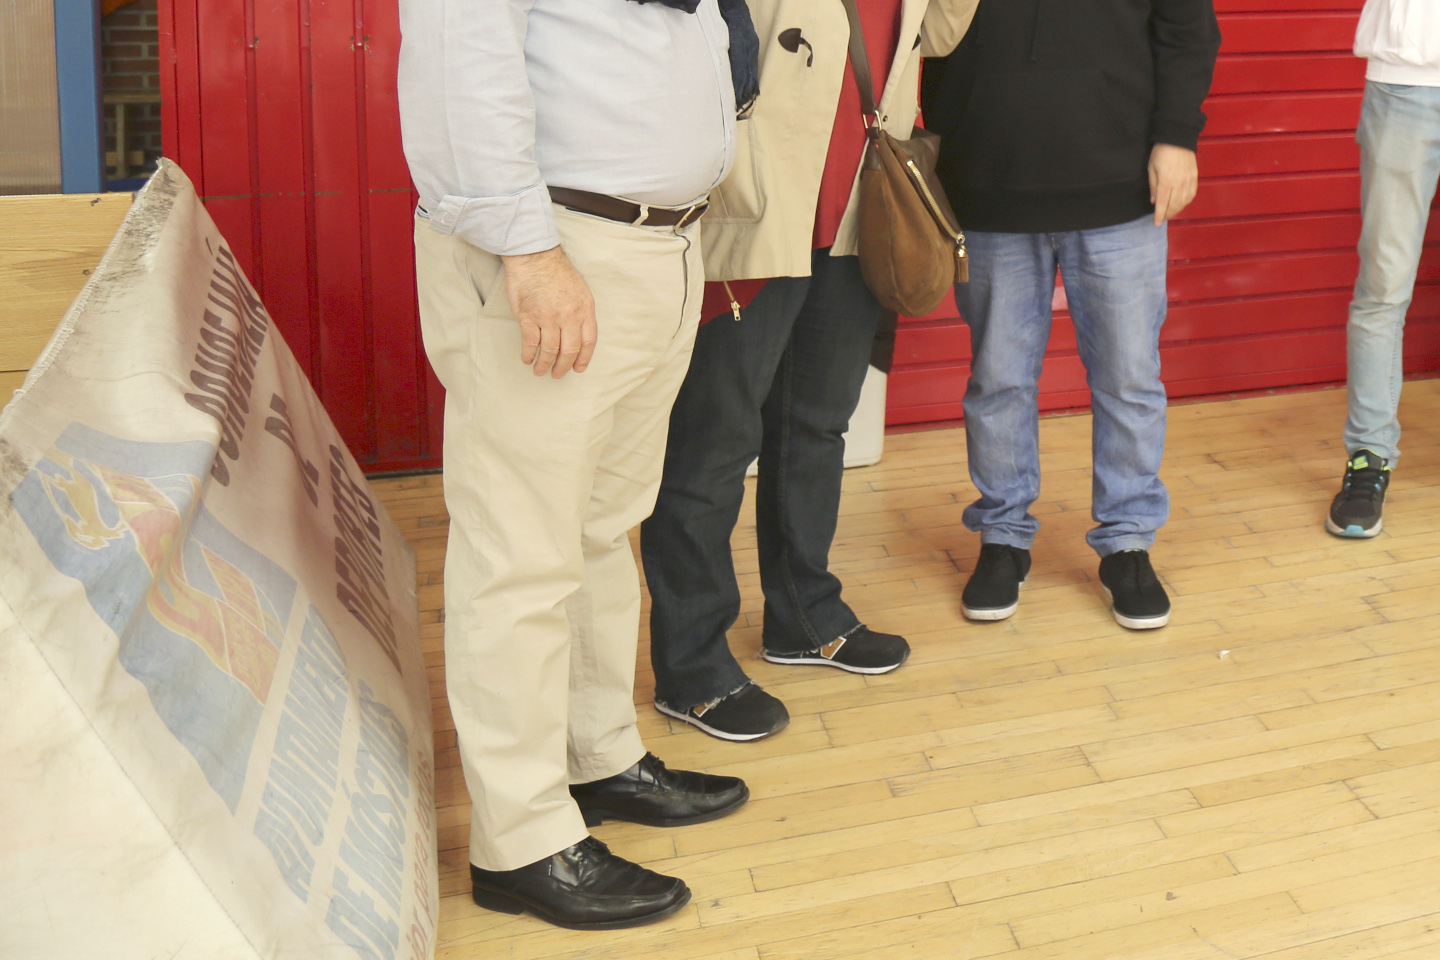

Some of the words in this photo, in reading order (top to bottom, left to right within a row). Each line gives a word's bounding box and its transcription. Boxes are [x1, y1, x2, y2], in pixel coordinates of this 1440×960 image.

[329, 444, 403, 678] DEPORTES
[252, 603, 350, 905] AYUNTAMIENTO
[338, 679, 410, 917] MÓSTOLES
